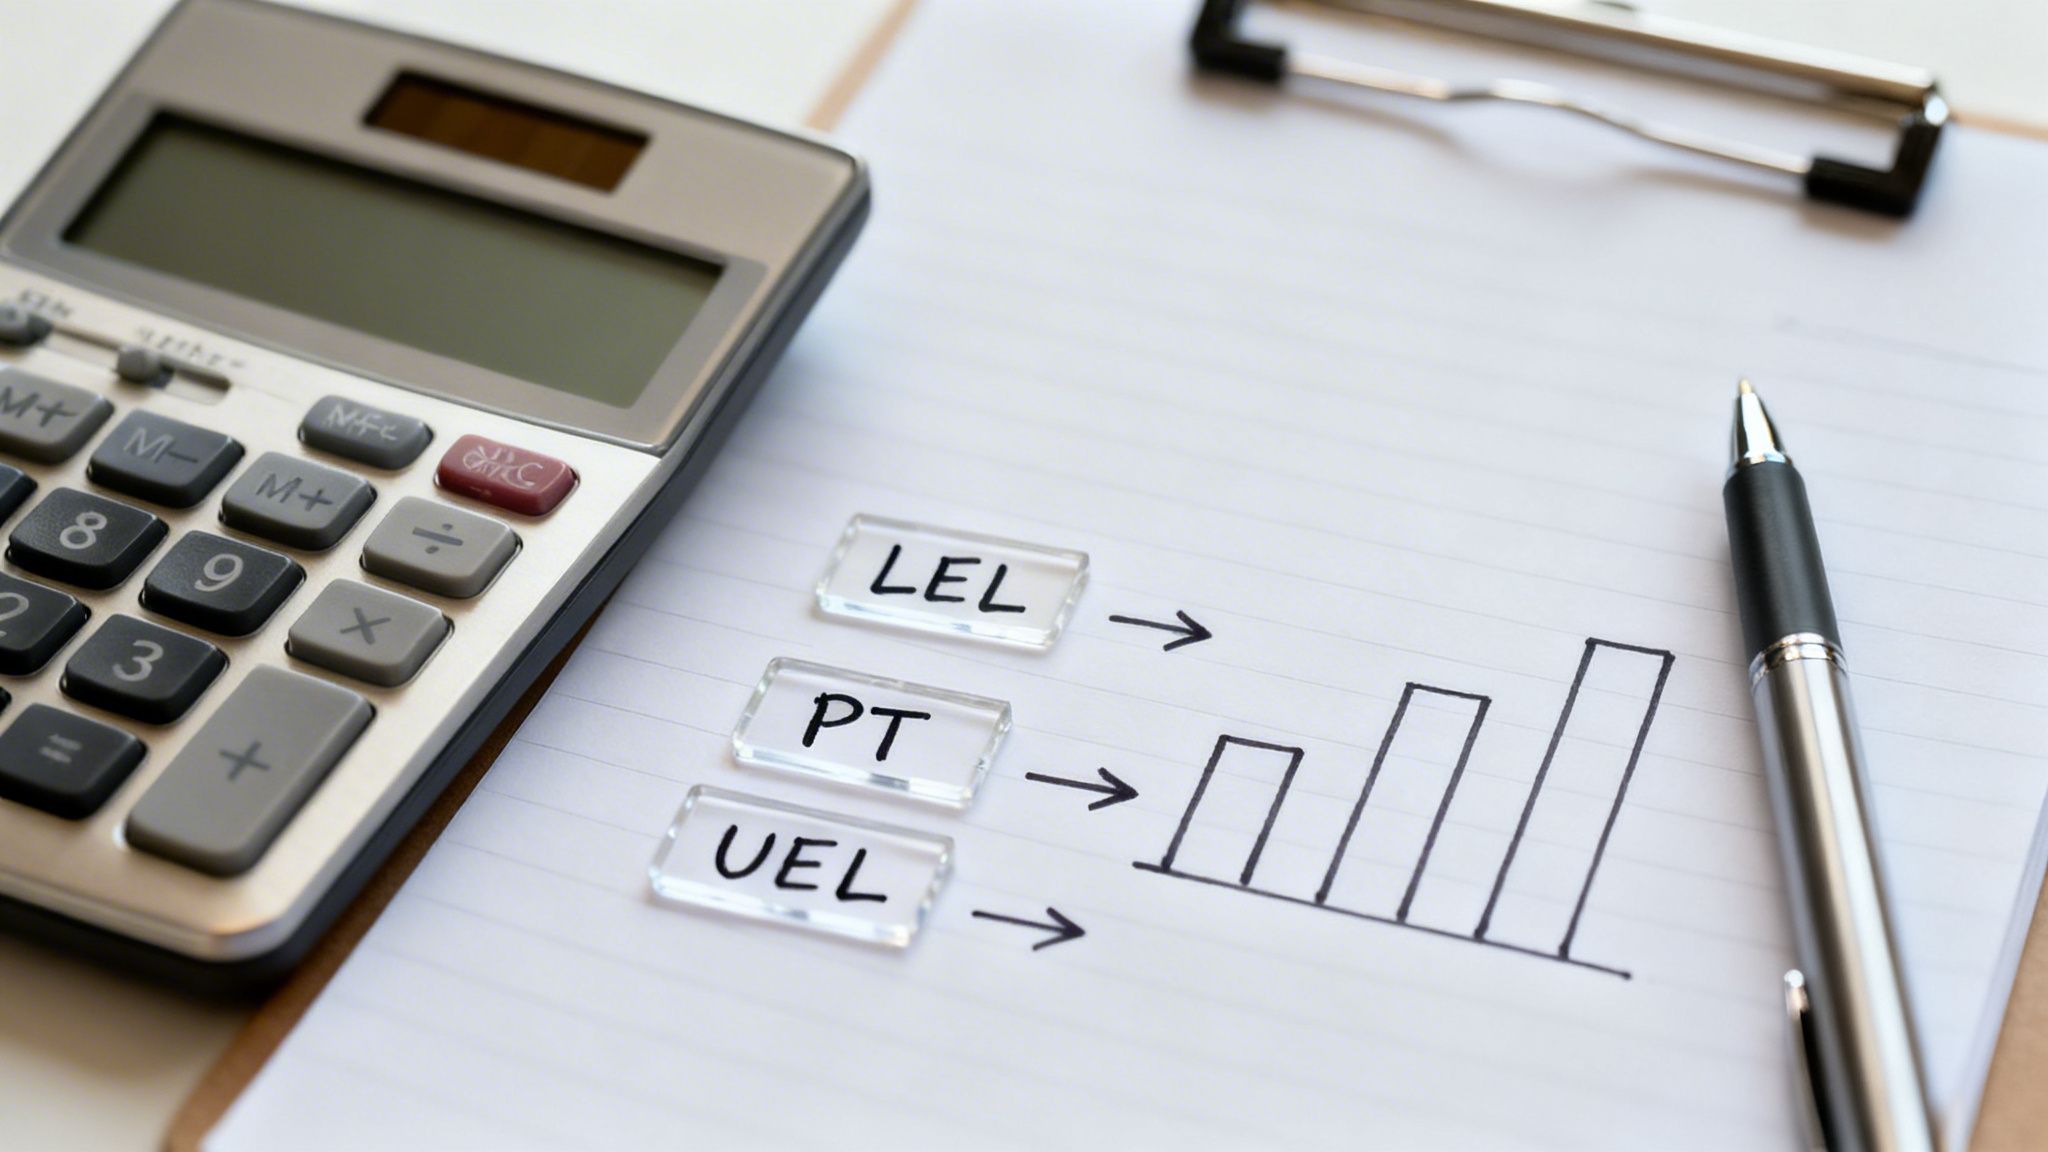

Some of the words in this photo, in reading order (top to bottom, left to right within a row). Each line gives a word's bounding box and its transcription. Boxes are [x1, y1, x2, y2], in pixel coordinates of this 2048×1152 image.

[255, 473, 334, 511] M+
[59, 511, 108, 550] 8
[194, 553, 243, 592] 9
[869, 544, 1026, 614] LEL
[112, 639, 164, 682] 3
[801, 691, 932, 762] PT
[714, 824, 888, 904] UEL
